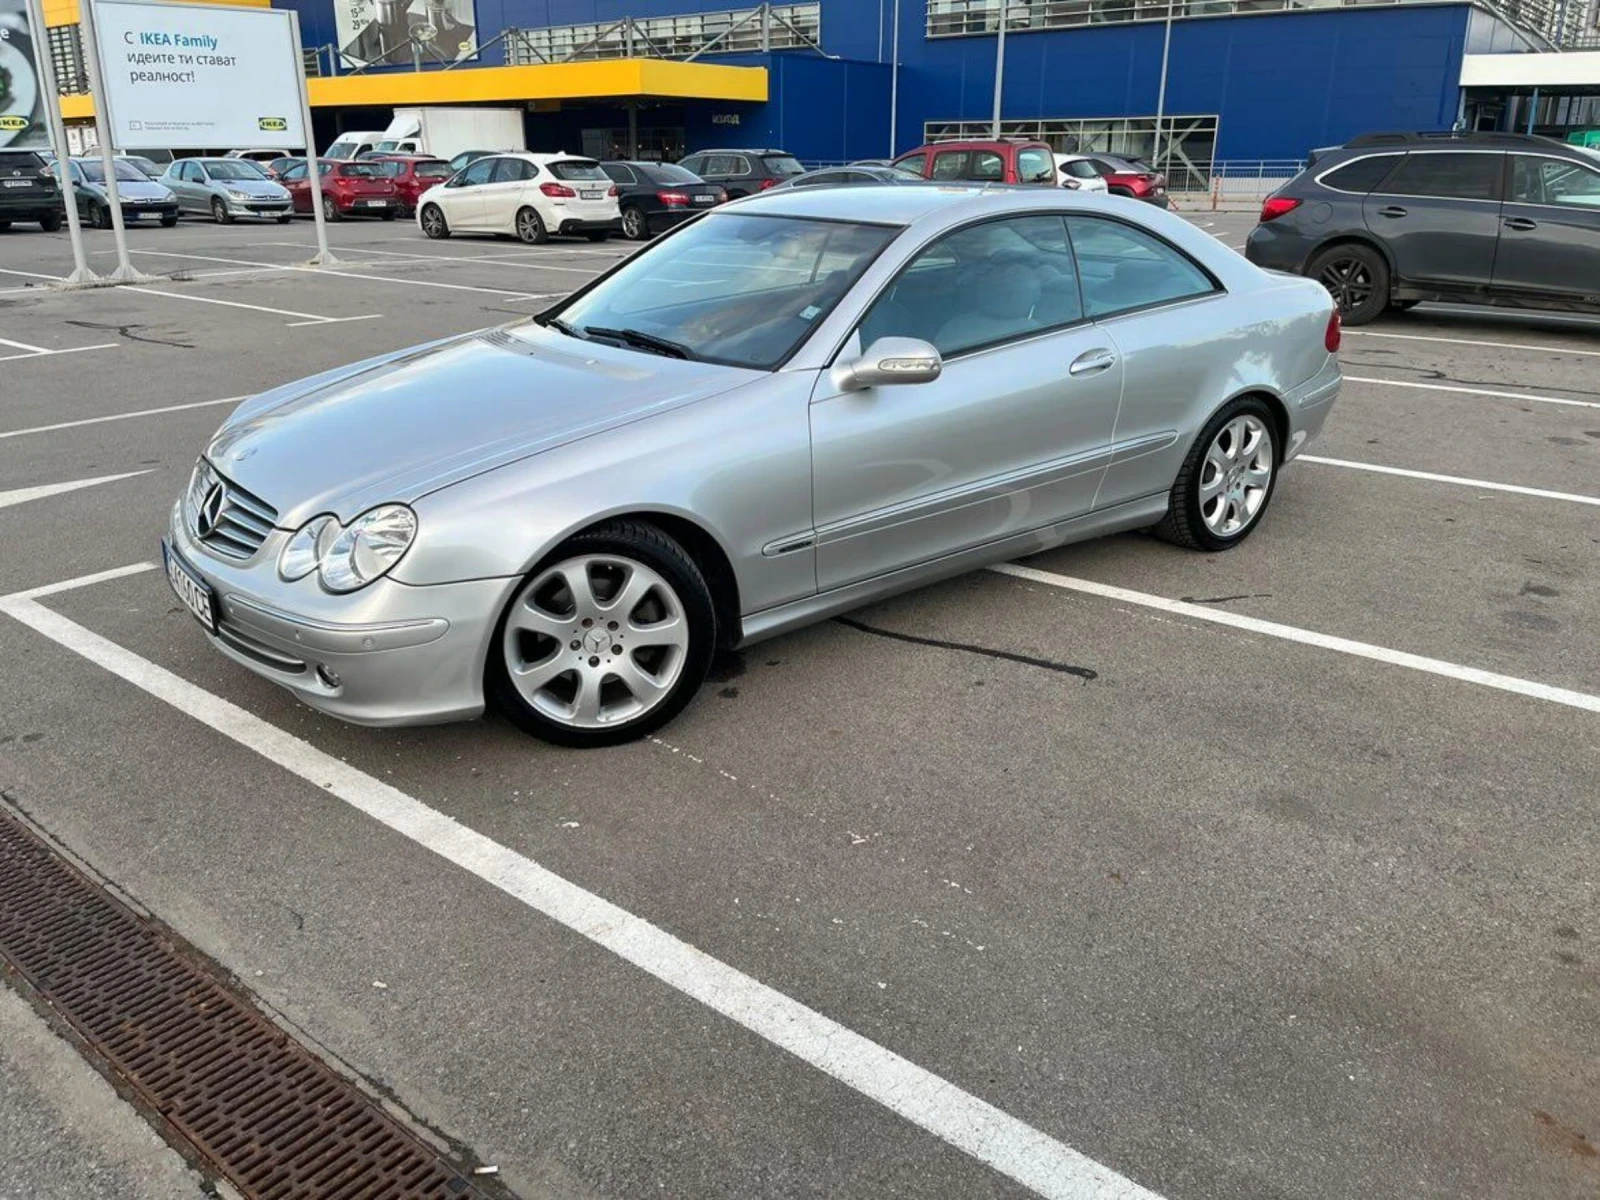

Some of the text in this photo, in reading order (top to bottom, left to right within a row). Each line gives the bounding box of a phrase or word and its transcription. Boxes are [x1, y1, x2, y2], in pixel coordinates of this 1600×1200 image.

[123, 31, 218, 51] С IKEA Family
[127, 52, 237, 67] идеите ти стават
[130, 70, 195, 85] реалност!
